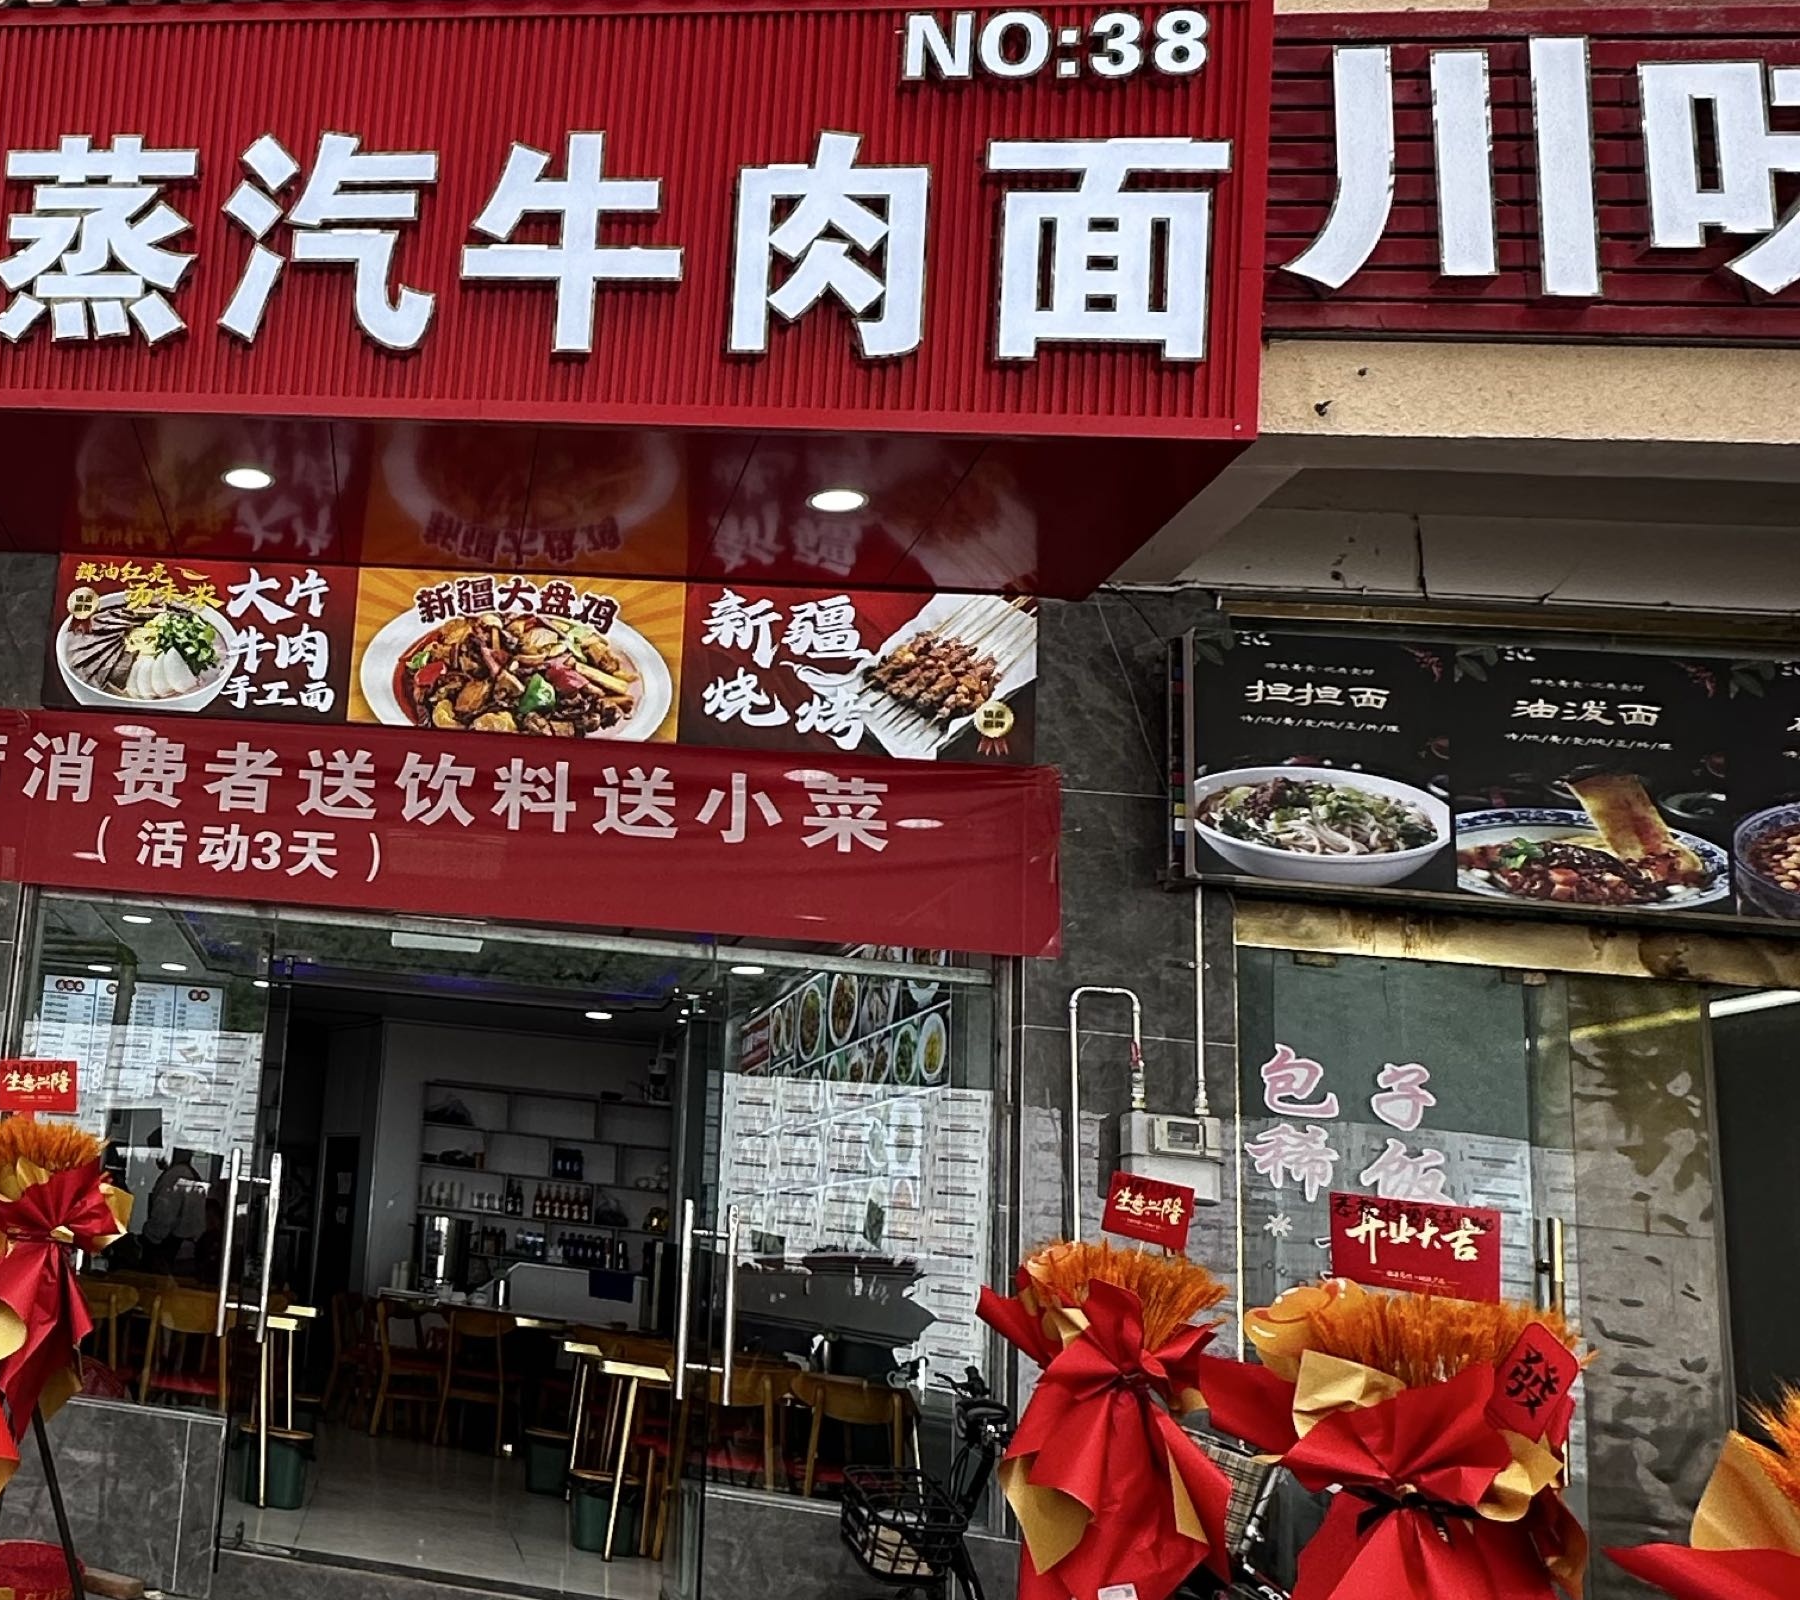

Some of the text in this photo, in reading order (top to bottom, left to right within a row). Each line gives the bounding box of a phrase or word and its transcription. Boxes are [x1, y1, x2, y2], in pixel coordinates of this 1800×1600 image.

[901, 8, 1210, 82] NO:38
[75, 560, 170, 584] 辣油红亮
[226, 568, 330, 624] 大片
[414, 576, 619, 635] 新疆大盘鸡
[701, 587, 873, 668] 新疆
[226, 623, 329, 680] 牛肉
[219, 675, 335, 713] 手工面
[701, 666, 873, 751] 烧烤
[1244, 679, 1390, 709] 担担面
[1510, 699, 1662, 726] 油泼面
[3, 1069, 73, 1094] 生意兴隆
[1260, 1042, 1437, 1132] 包子
[1243, 1123, 1458, 1205] 稀饭
[1112, 1186, 1186, 1226] 生意兴隆
[1344, 1206, 1487, 1265] 开业大吉
